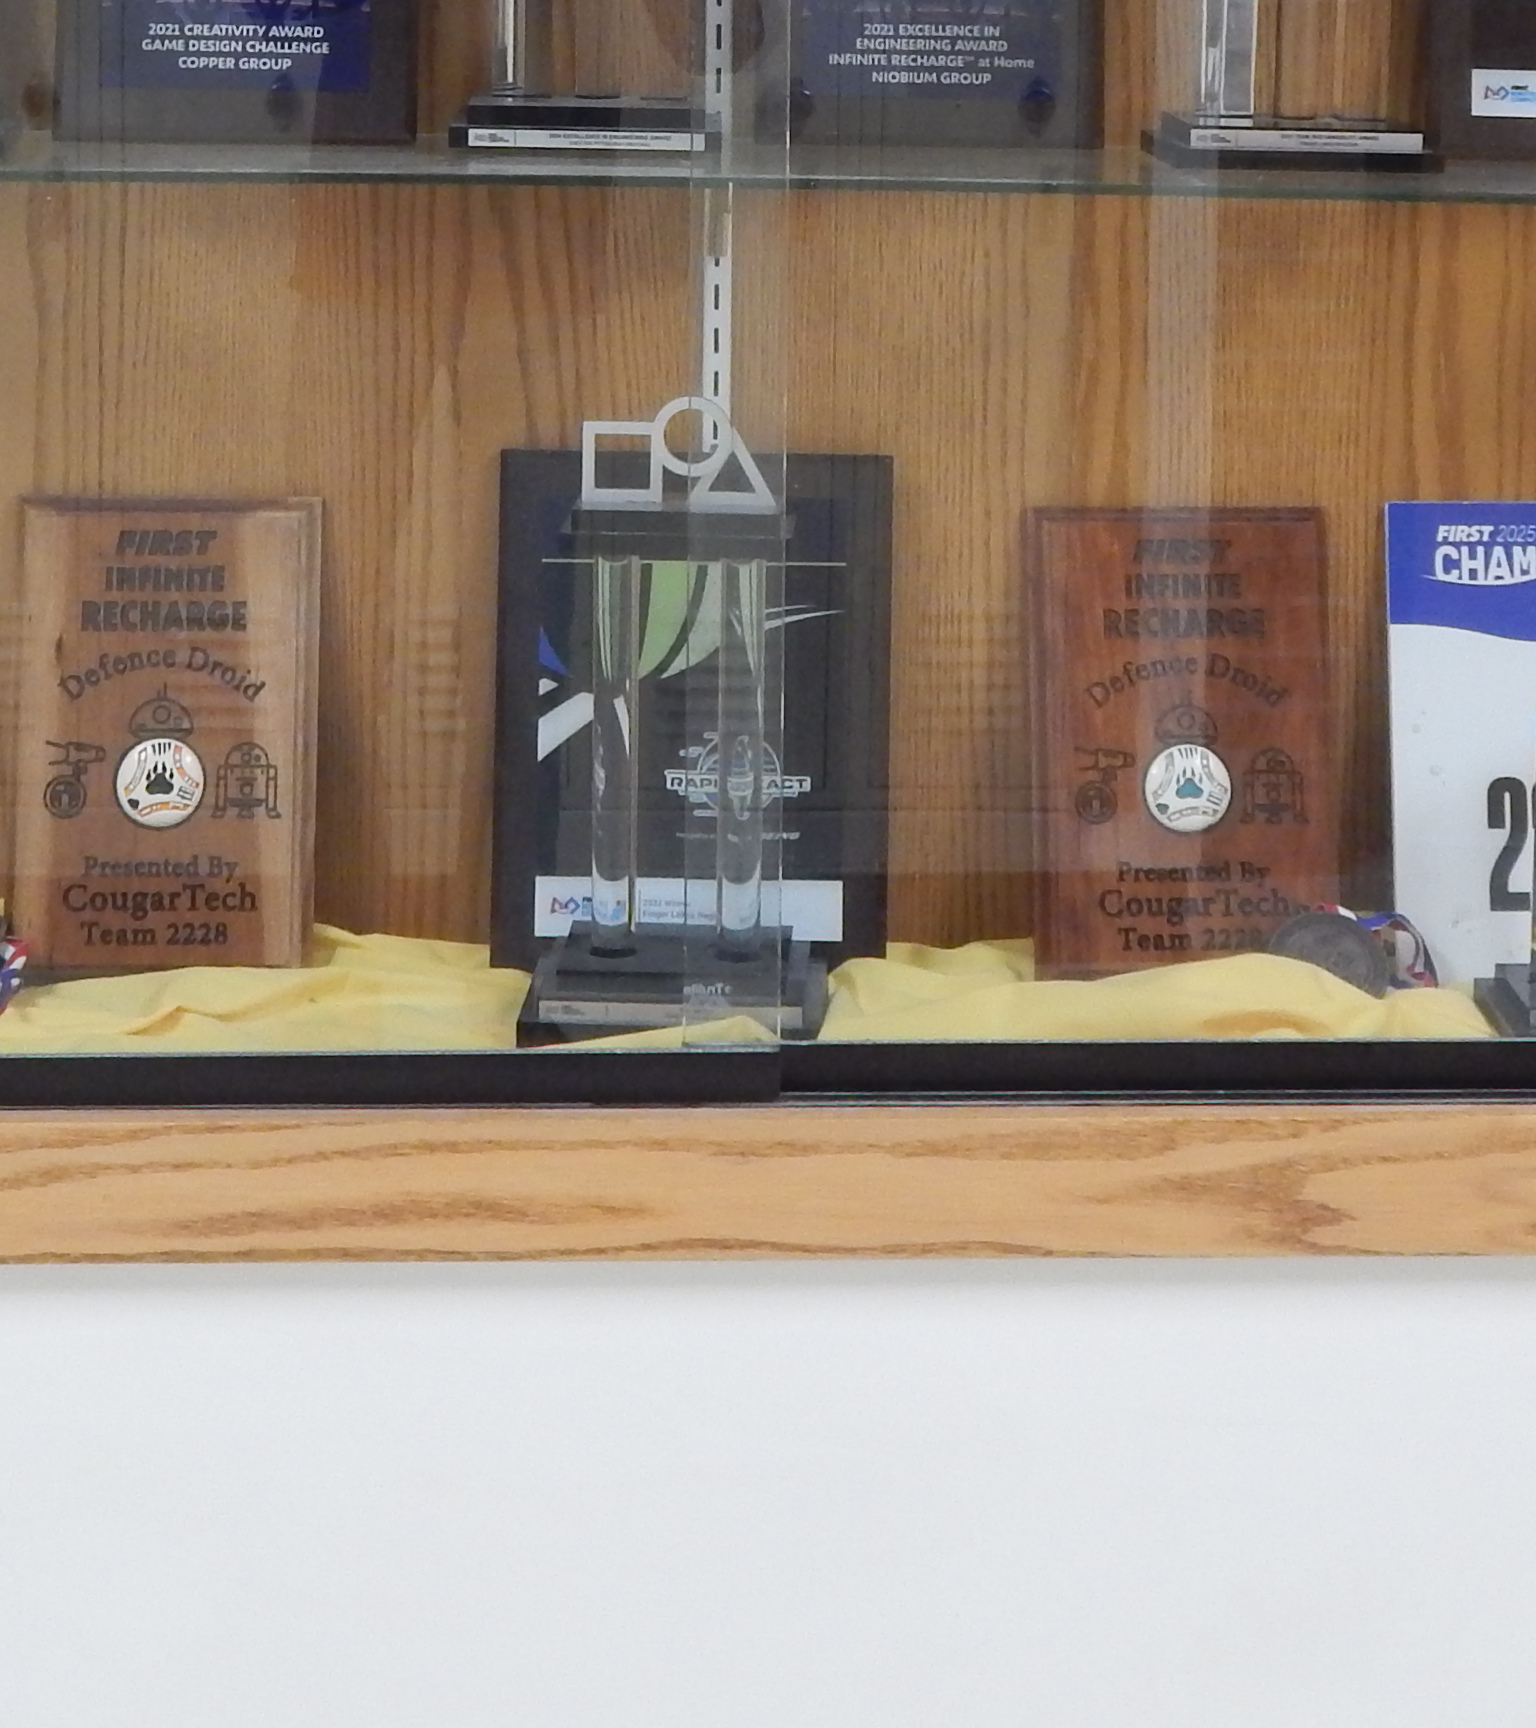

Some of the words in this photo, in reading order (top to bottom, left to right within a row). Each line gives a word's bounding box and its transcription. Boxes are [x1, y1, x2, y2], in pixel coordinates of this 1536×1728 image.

[148, 23, 180, 36] 2021
[184, 24, 265, 37] CREATIVITY
[268, 26, 325, 38] AWARD
[863, 23, 896, 36] 2021
[899, 24, 981, 37] EXCELLENCE
[984, 26, 1000, 37] IN
[142, 39, 185, 51] GAME
[189, 40, 242, 52] DESIGN
[246, 41, 330, 54] CHALLENGE
[856, 38, 952, 52] ENGINEERING
[955, 40, 1008, 53] AWARD
[178, 56, 235, 70] COPPER
[238, 57, 293, 71] GROUP
[829, 53, 887, 66] INFINITE
[978, 58, 991, 69] at
[994, 57, 1035, 70] Home
[872, 72, 937, 85] NIOBIUM
[940, 73, 992, 86] GROUP
[115, 529, 218, 557] FIRST
[1436, 524, 1495, 543] FIRST
[1496, 525, 1536, 543] 2025
[1132, 538, 1232, 564] FIRST
[104, 564, 226, 593] INFINITE
[1124, 573, 1242, 600] INFINITE
[80, 600, 248, 633] RECHARGE
[1103, 607, 1267, 639] RECHARGE
[58, 646, 177, 704] Defence
[187, 646, 266, 704] Droid
[1084, 652, 1198, 710] Defence
[1207, 652, 1290, 708] Droid
[83, 855, 195, 879] Presented
[208, 856, 238, 885] By
[1116, 861, 1232, 883] Presented
[1240, 862, 1270, 889] By
[63, 883, 259, 920] CougarTech
[1099, 889, 1290, 927] CougarTech
[80, 921, 156, 947] Team
[166, 922, 229, 947] 2228
[1117, 927, 1192, 952] Team
